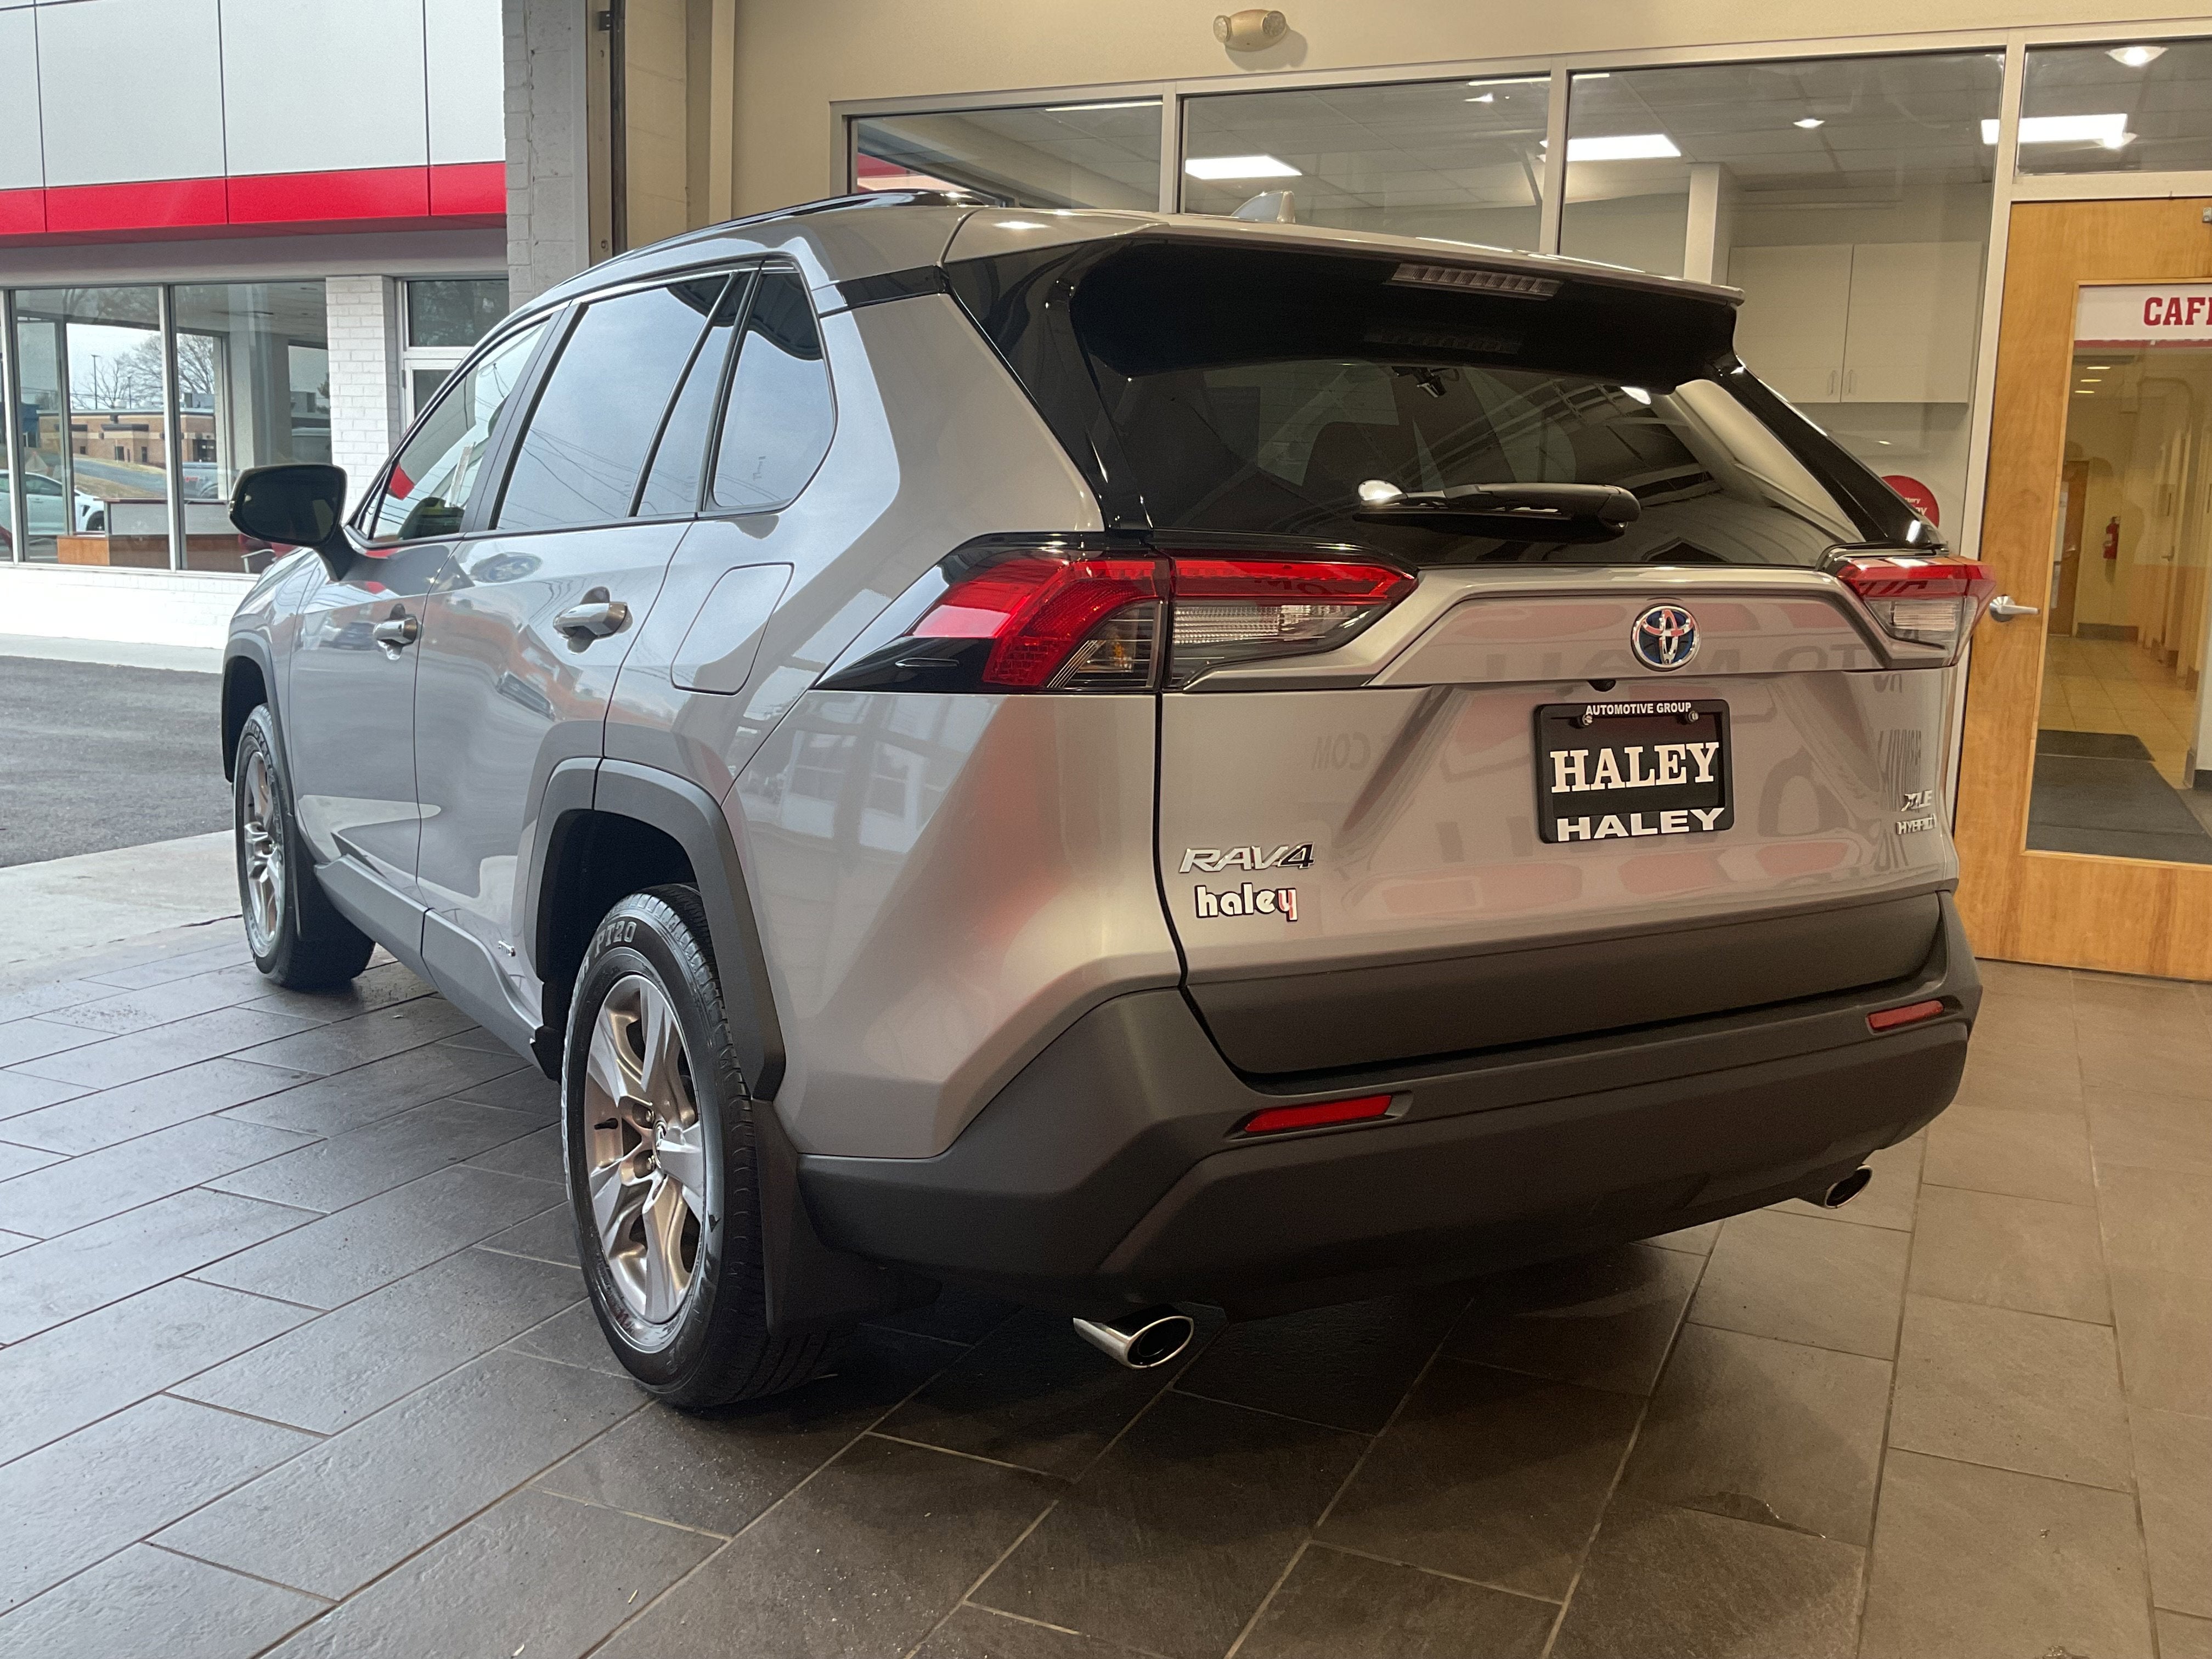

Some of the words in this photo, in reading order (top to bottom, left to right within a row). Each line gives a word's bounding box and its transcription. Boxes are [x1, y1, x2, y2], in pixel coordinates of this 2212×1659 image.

[1585, 703, 1654, 716] AUTOMOTIVE
[1656, 702, 1691, 713] GROUP
[1550, 742, 1719, 793] HALEY
[1556, 807, 1725, 842] HALEY
[1180, 841, 1316, 873] RAV4
[1194, 882, 1298, 922] haley
[594, 921, 637, 958] PT20
